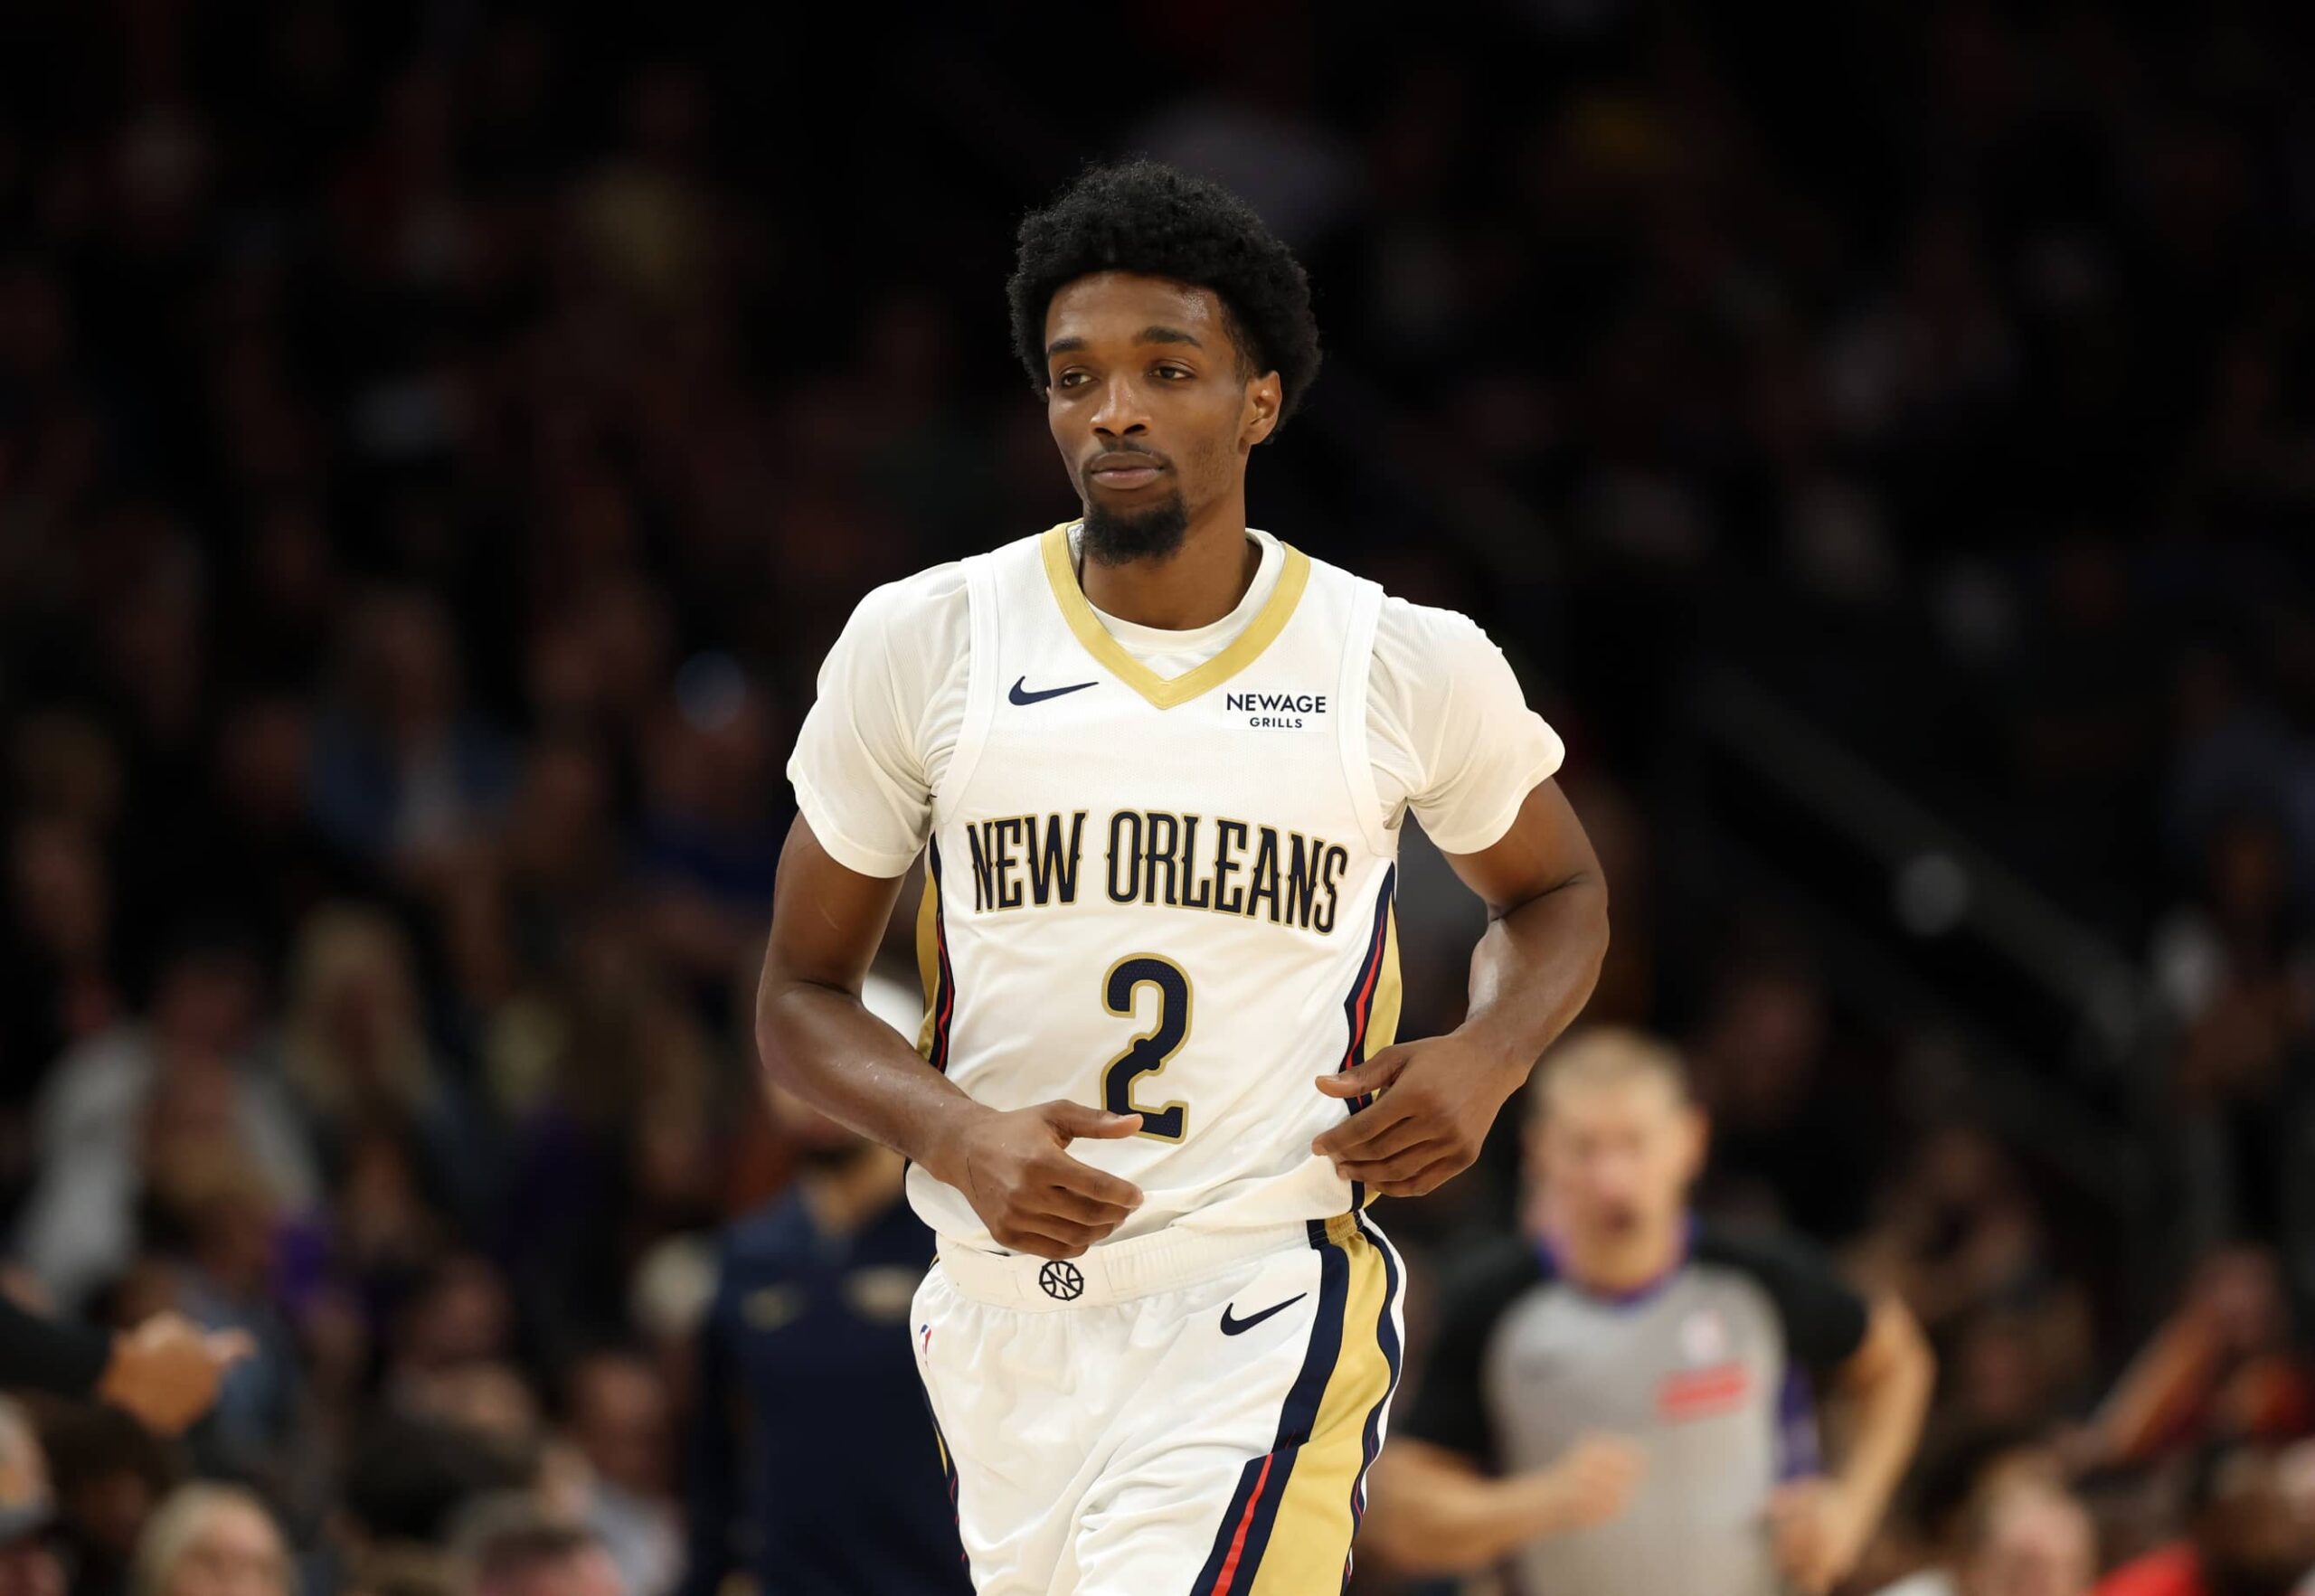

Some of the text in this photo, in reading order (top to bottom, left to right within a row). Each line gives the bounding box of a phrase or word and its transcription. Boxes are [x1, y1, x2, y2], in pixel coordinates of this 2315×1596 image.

[1226, 693, 1326, 713] NEWAGE
[1250, 717, 1302, 728] GRILLS
[966, 808, 1348, 936] NEW ORLEANS
[1100, 952, 1194, 1145] 2
